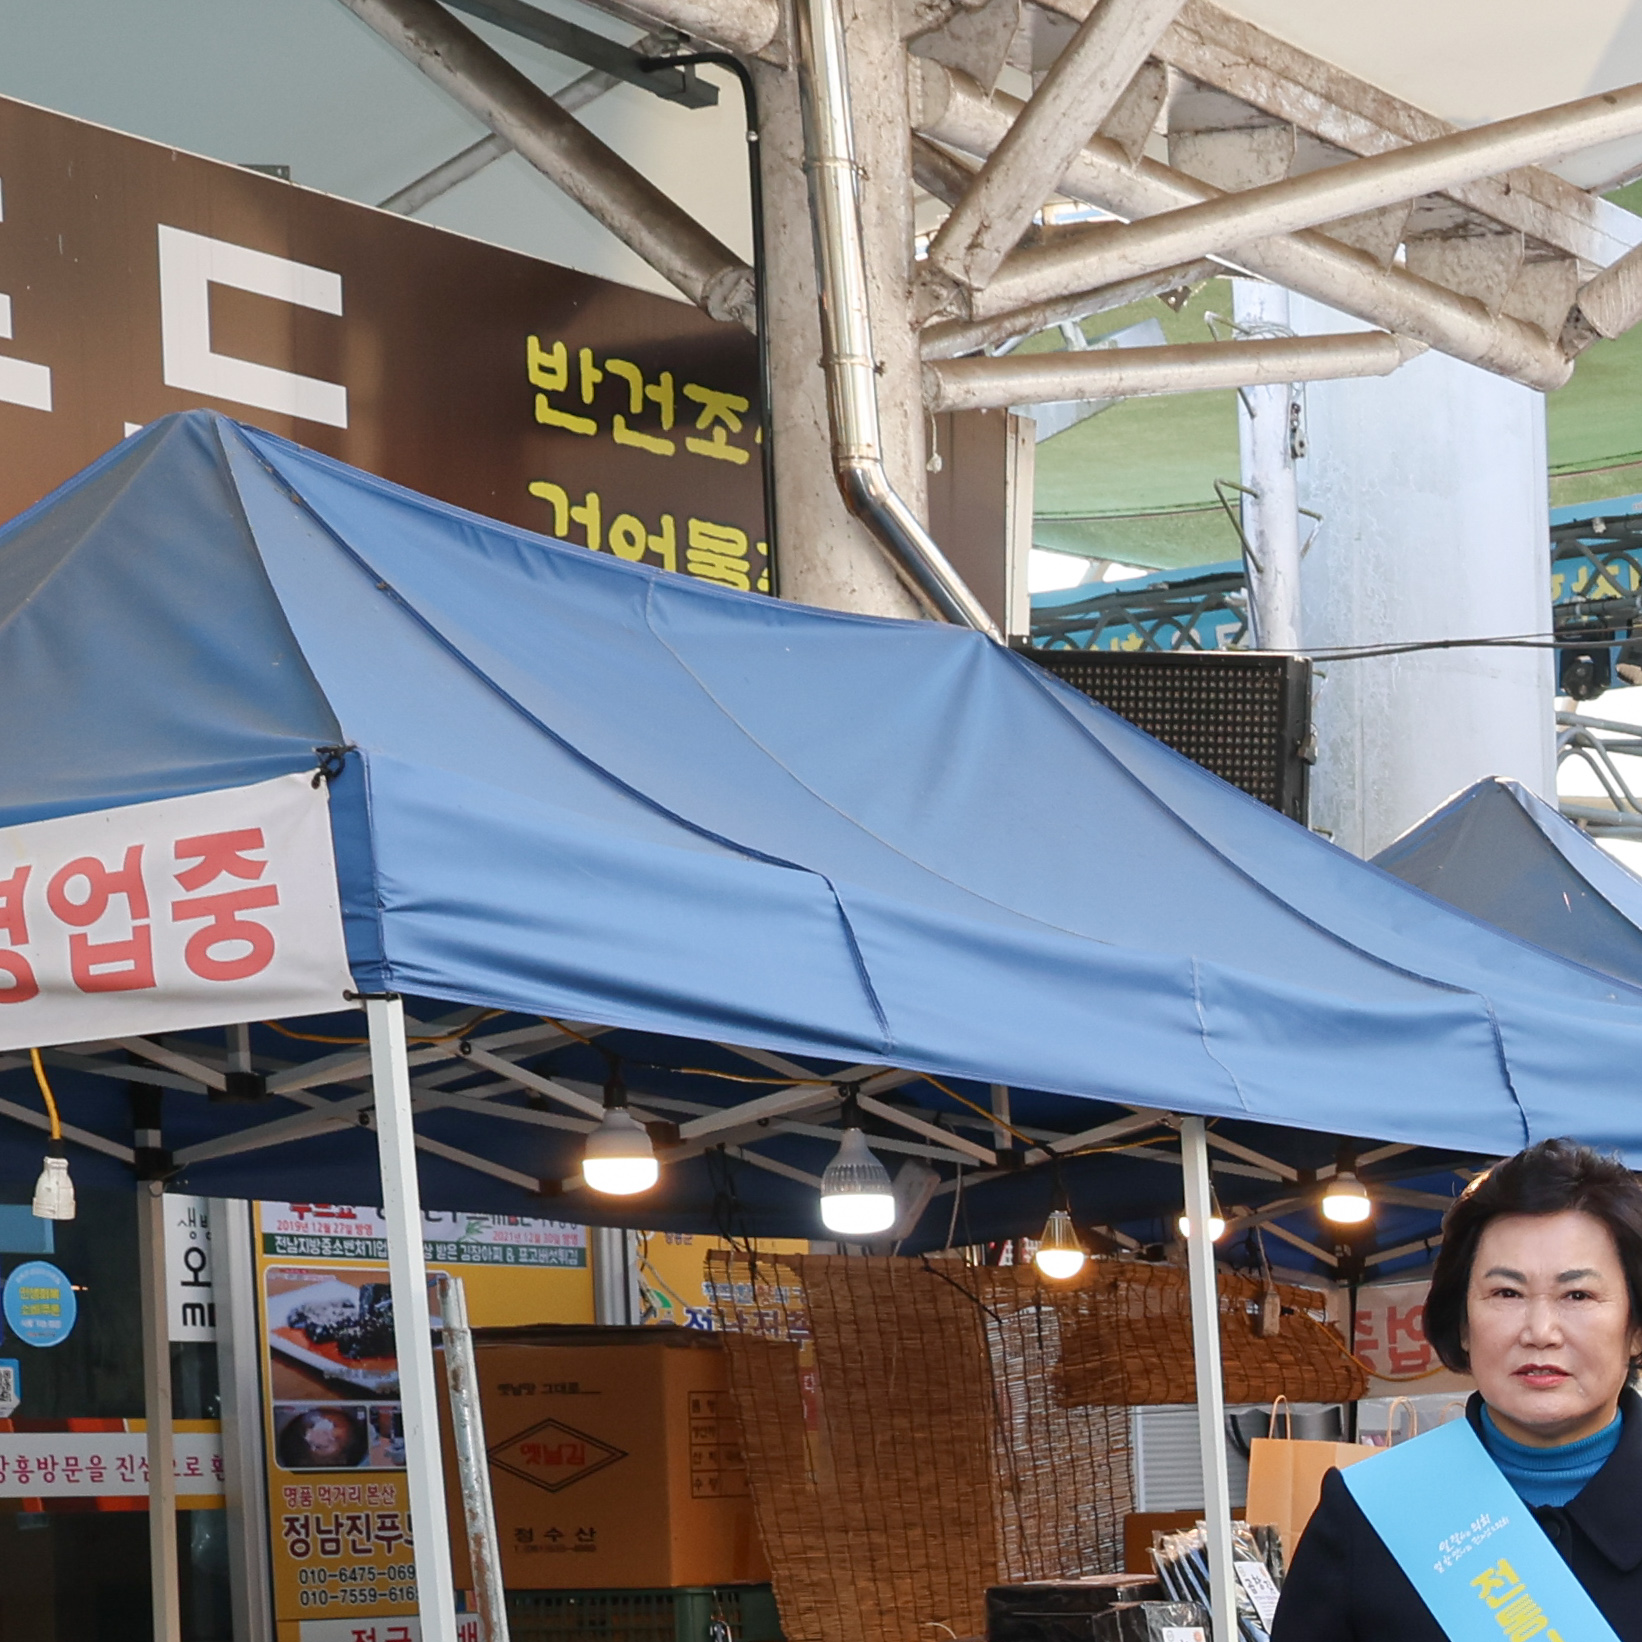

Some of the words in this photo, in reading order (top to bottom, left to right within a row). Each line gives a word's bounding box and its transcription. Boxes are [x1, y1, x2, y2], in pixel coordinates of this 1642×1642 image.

[526, 333, 763, 465] 반건조
[282, 1485, 313, 1509] 명품
[318, 1483, 362, 1508] 먹거리
[299, 1564, 417, 1586] 010-6475-069
[300, 1585, 420, 1607] 010-7559-616
